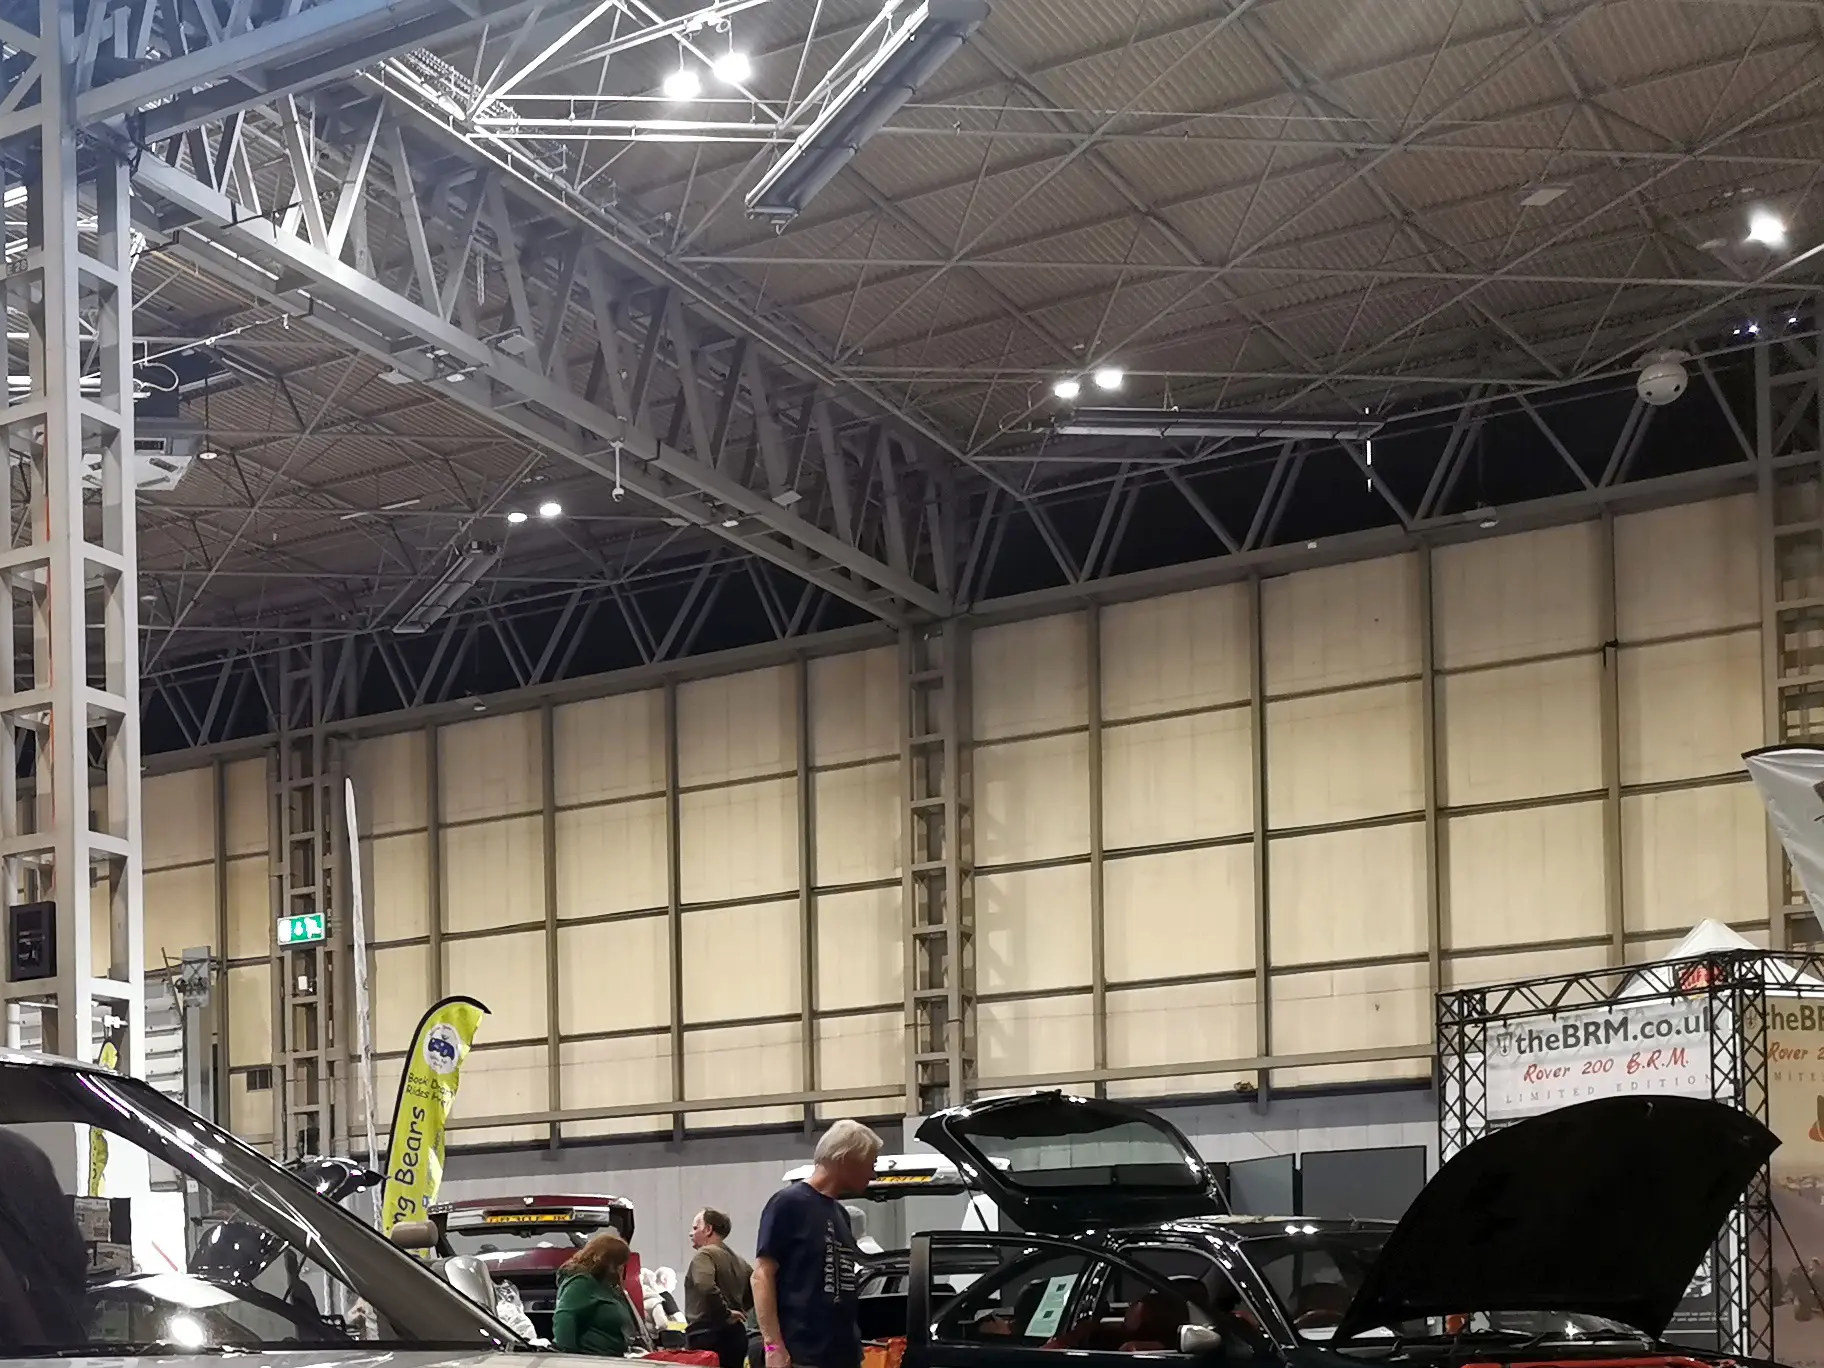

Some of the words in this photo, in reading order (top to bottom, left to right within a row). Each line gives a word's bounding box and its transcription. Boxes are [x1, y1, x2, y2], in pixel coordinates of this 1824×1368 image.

[1524, 1063, 1571, 1084] Rover
[1582, 1058, 1615, 1075] 200
[1626, 1047, 1689, 1075] B.R.M.
[1768, 1041, 1808, 1062] Rover
[1506, 1086, 1595, 1104] LIMITED
[394, 1106, 425, 1186] Bears
